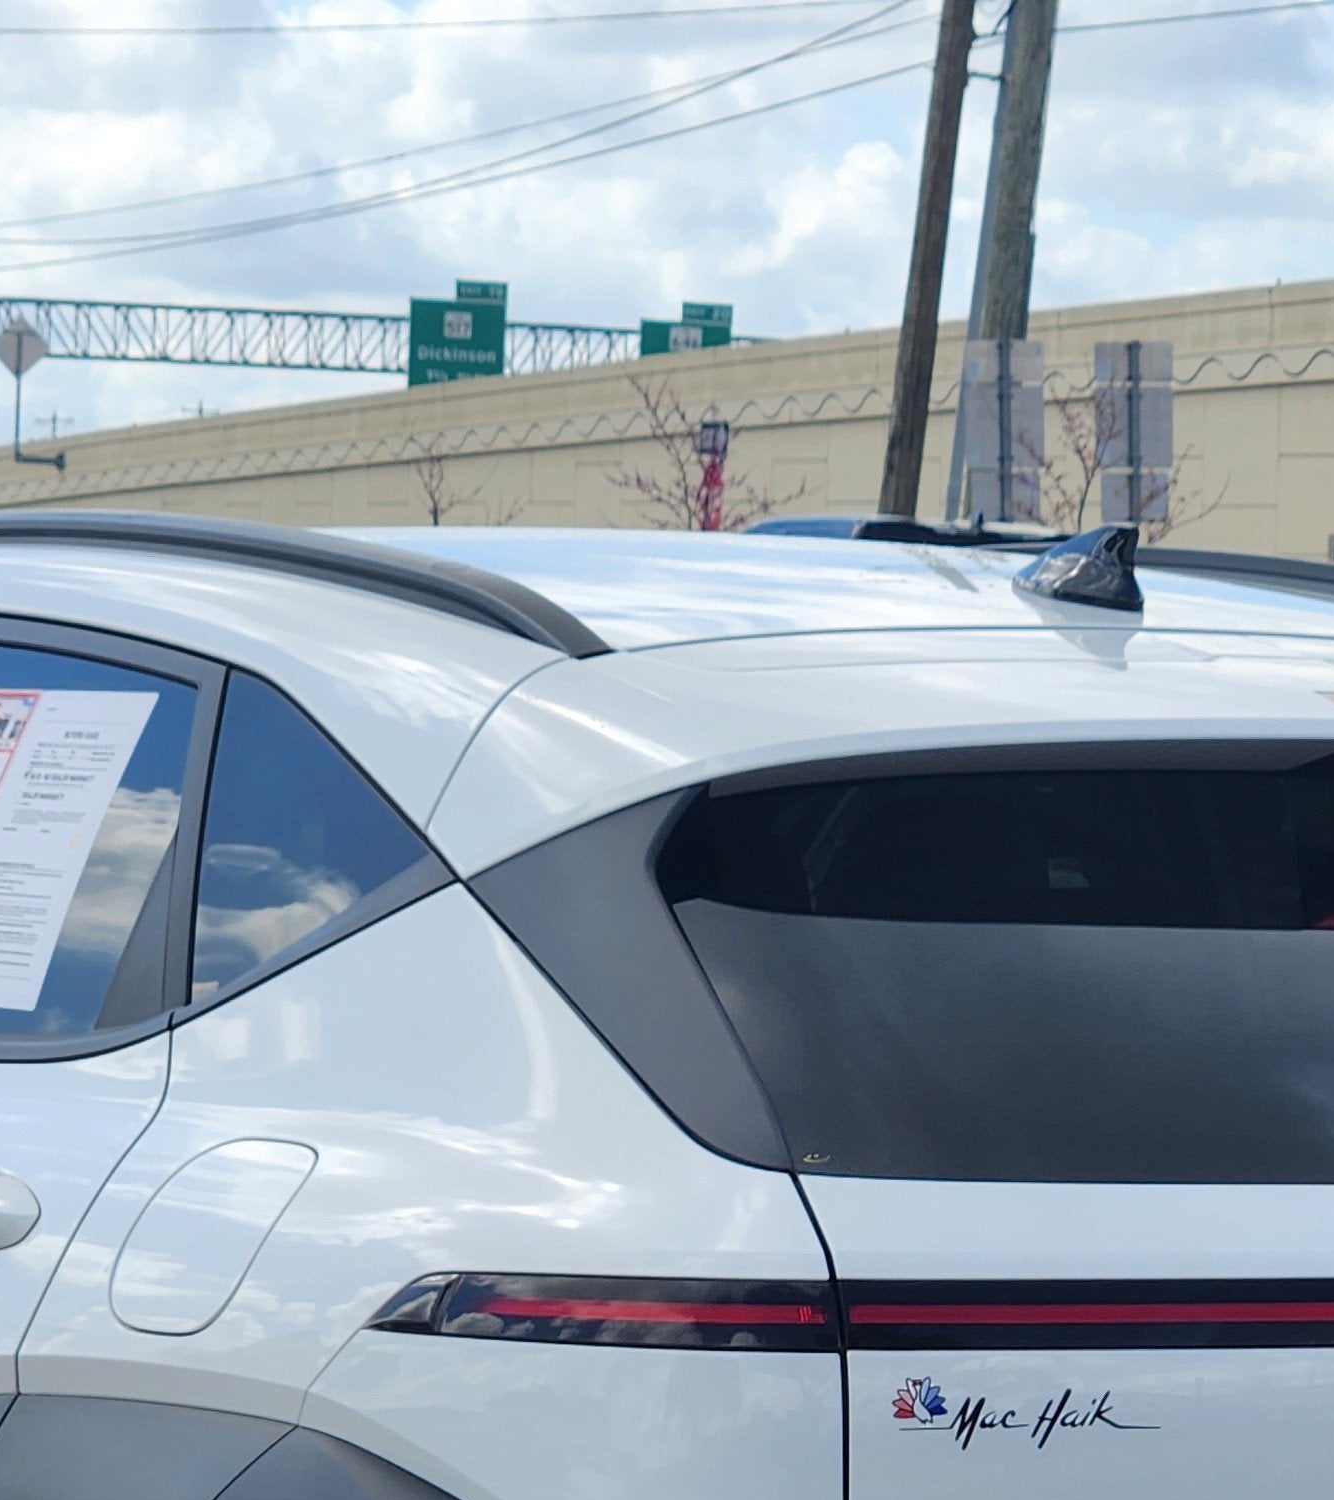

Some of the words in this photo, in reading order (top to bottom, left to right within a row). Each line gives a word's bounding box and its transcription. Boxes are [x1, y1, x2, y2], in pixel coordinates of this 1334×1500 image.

[416, 345, 497, 364] Dickinson
[929, 1397, 1029, 1451] Mac
[1030, 1388, 1161, 1449] Haik
